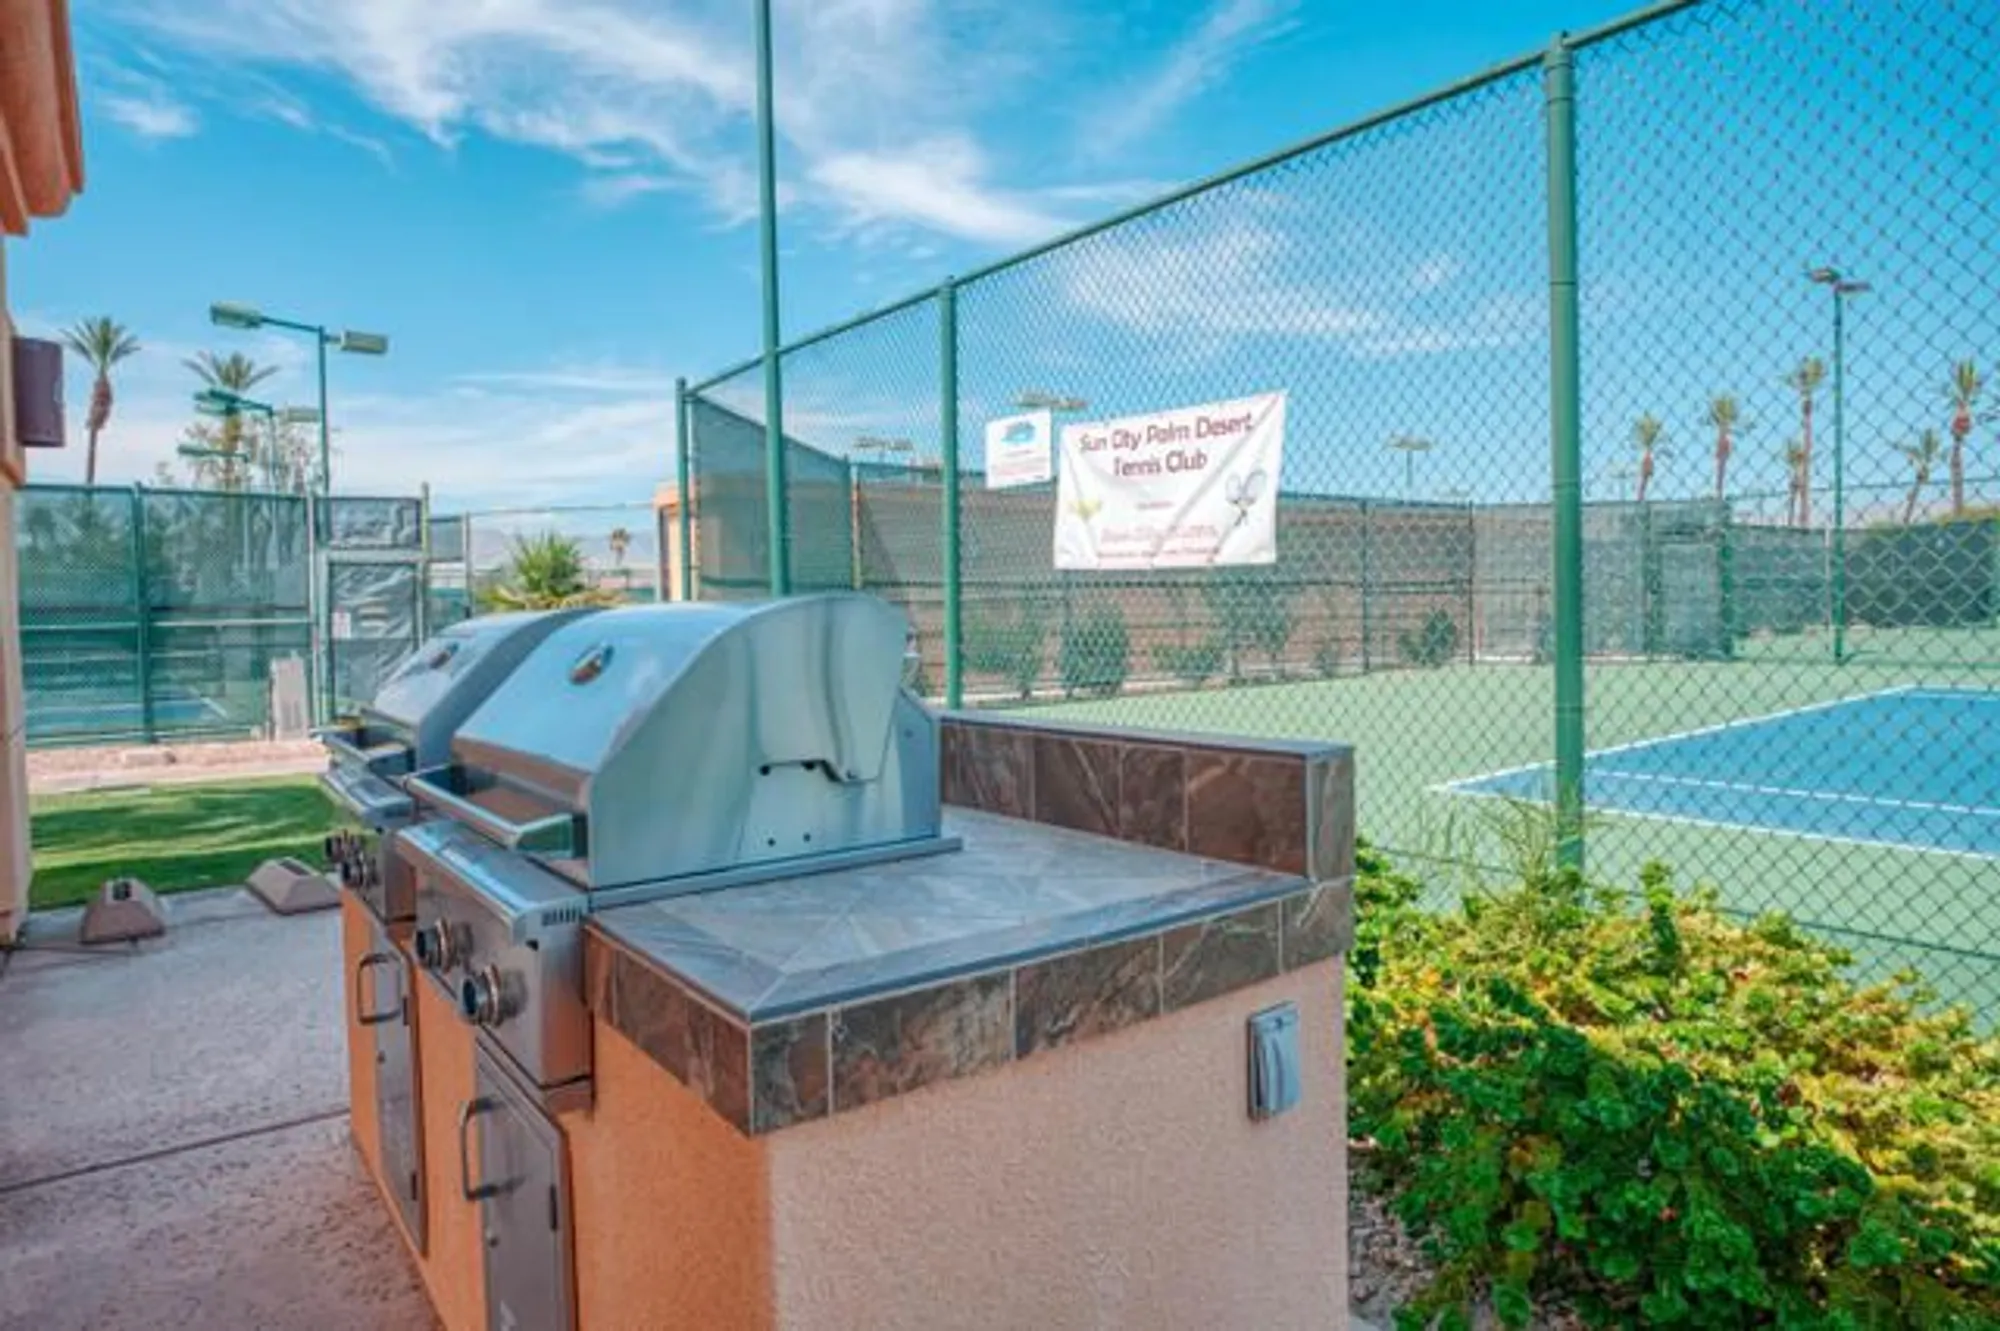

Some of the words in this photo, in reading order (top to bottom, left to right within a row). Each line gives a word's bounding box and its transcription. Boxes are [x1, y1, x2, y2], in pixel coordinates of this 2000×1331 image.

[1147, 421, 1190, 444] Palm
[1195, 412, 1253, 439] Desert
[1114, 457, 1161, 477] Tennis
[1166, 449, 1208, 473] Club
